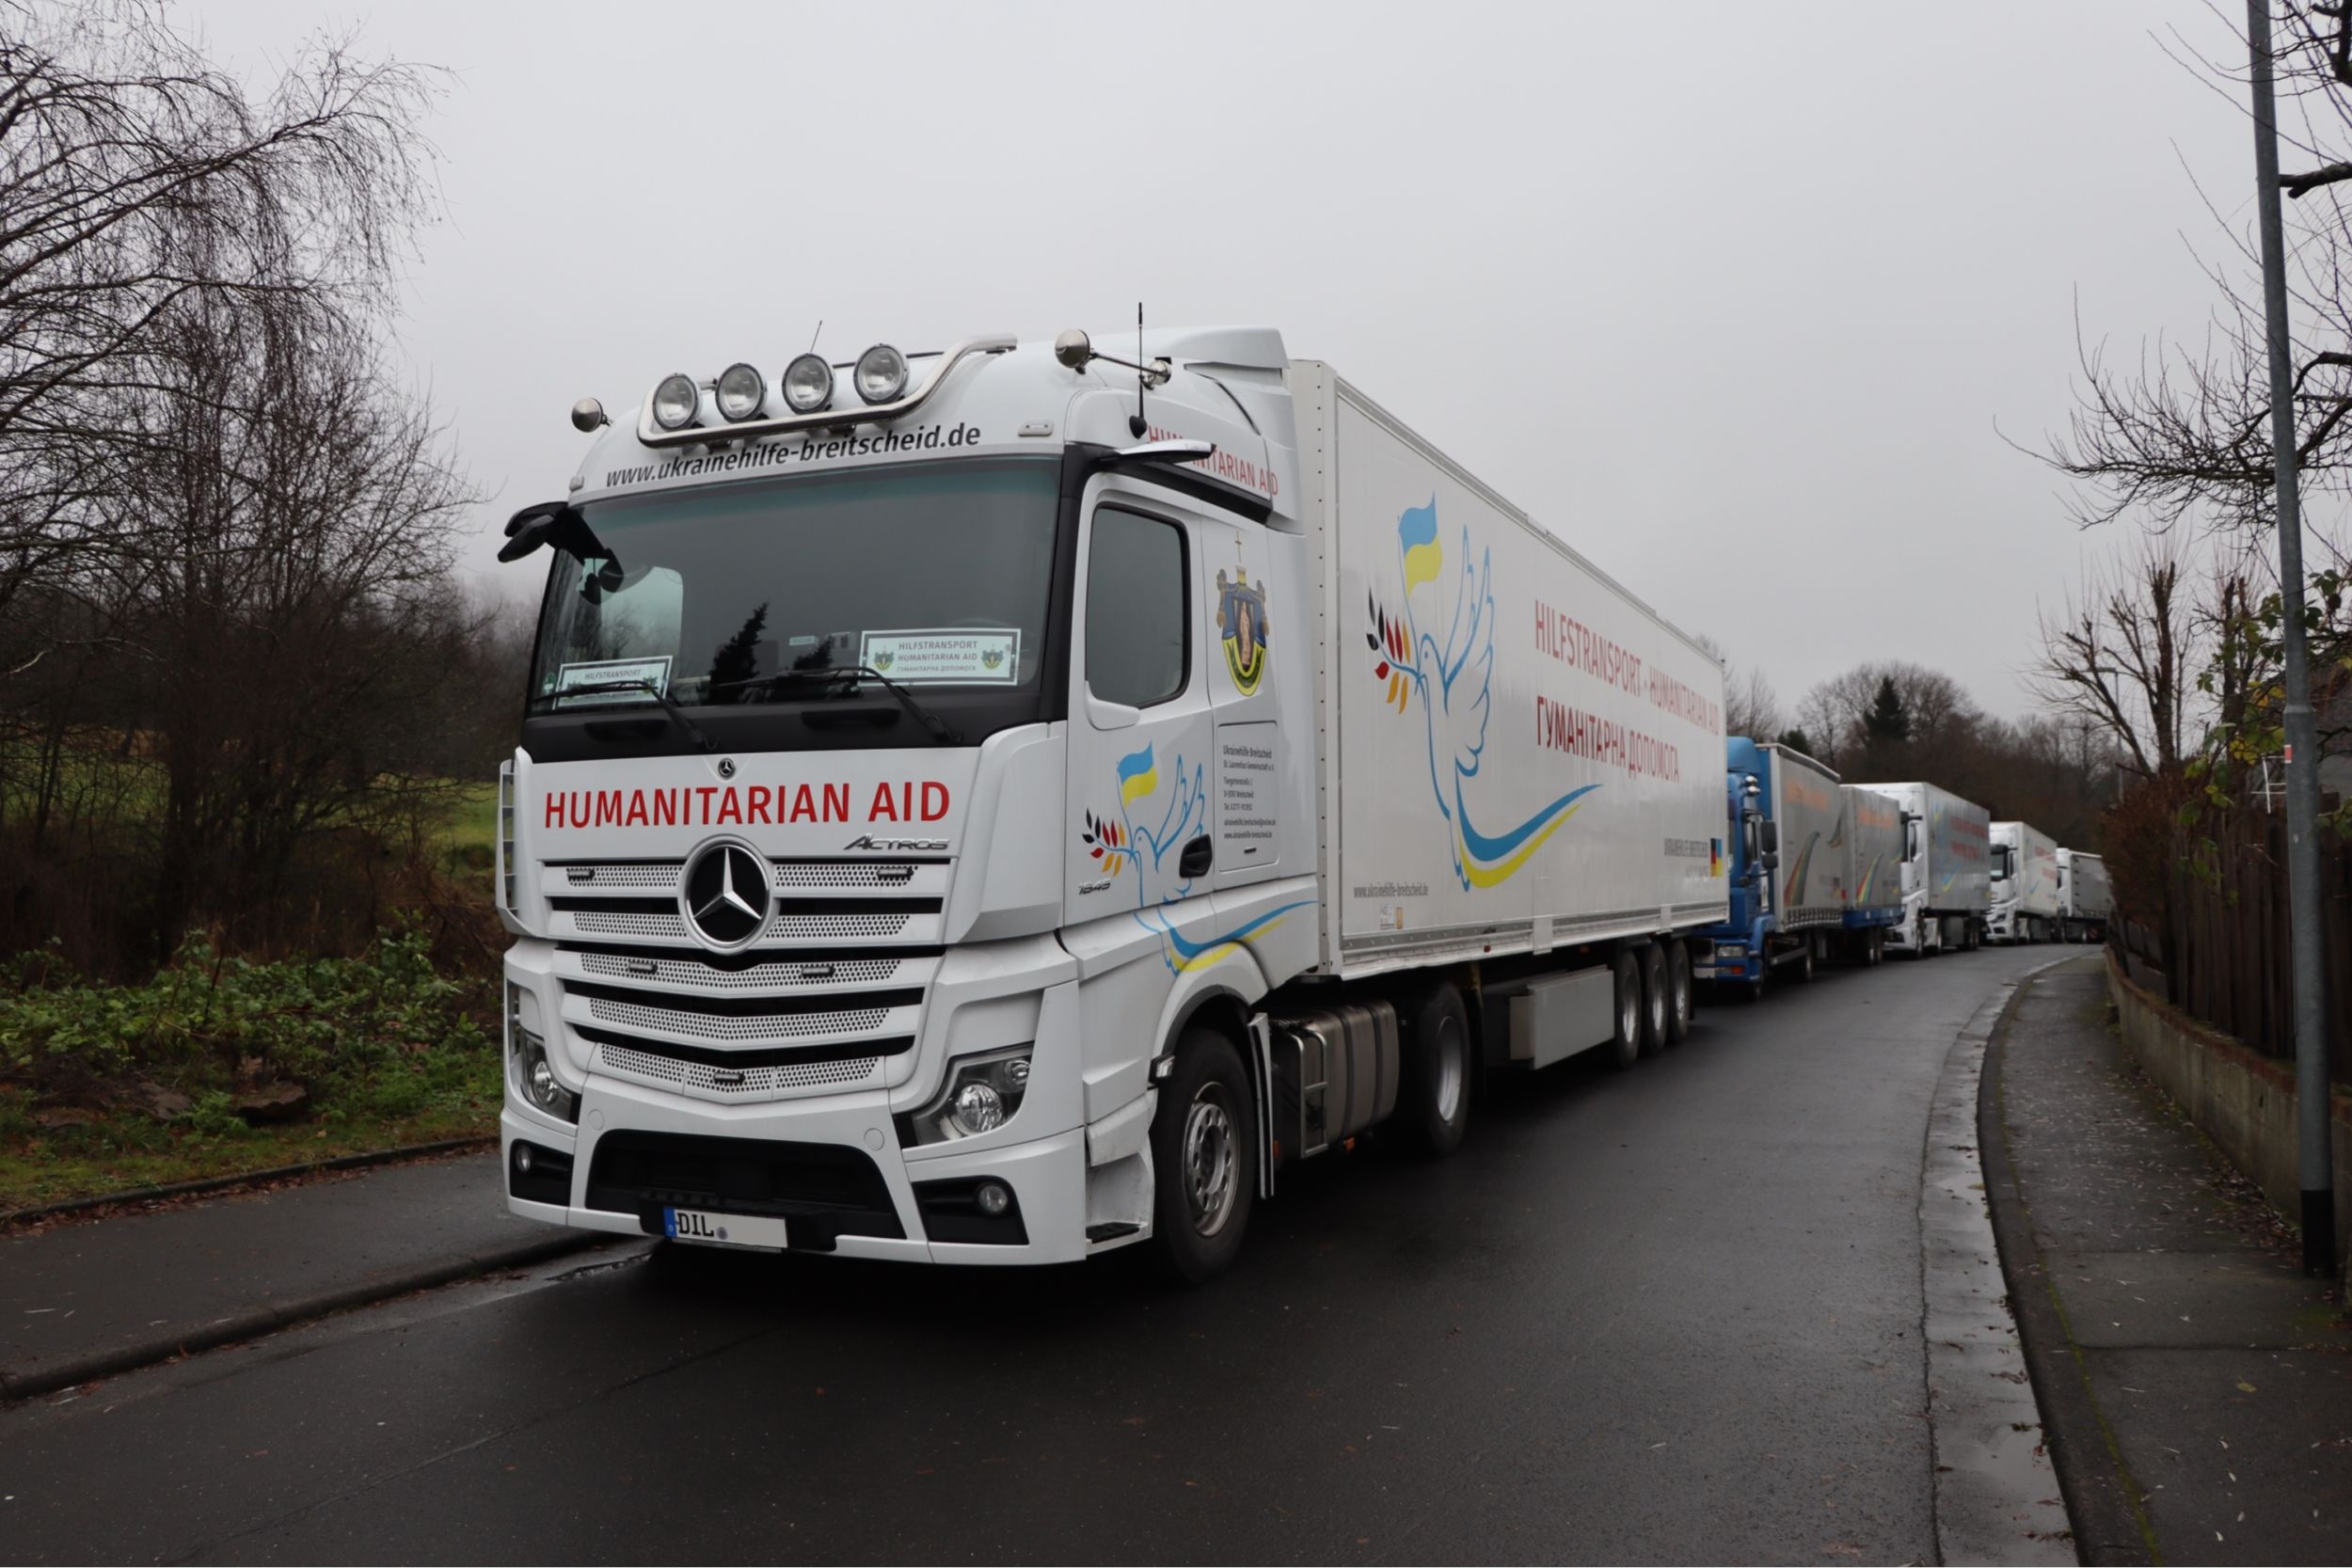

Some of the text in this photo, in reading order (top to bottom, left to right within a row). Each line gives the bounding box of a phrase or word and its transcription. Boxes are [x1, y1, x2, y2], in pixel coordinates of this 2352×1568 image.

[605, 421, 981, 487] www.ukrainehilfe-breitscheid.de
[1260, 467, 1279, 497] AID
[898, 641, 977, 650] HILFSTRANSPORT
[898, 653, 977, 662] HUMANITARIAN AID
[1534, 598, 1642, 698] HILFSTRANSPORT
[584, 669, 642, 680] HILFSTRANSPORT
[940, 664, 977, 673] ДОПОМОГА
[1536, 695, 1680, 784] ГУМАНІТАРНА ДОПОМОГА
[545, 782, 950, 828] HUMANITARIAN AID
[676, 1212, 715, 1237] DIL
